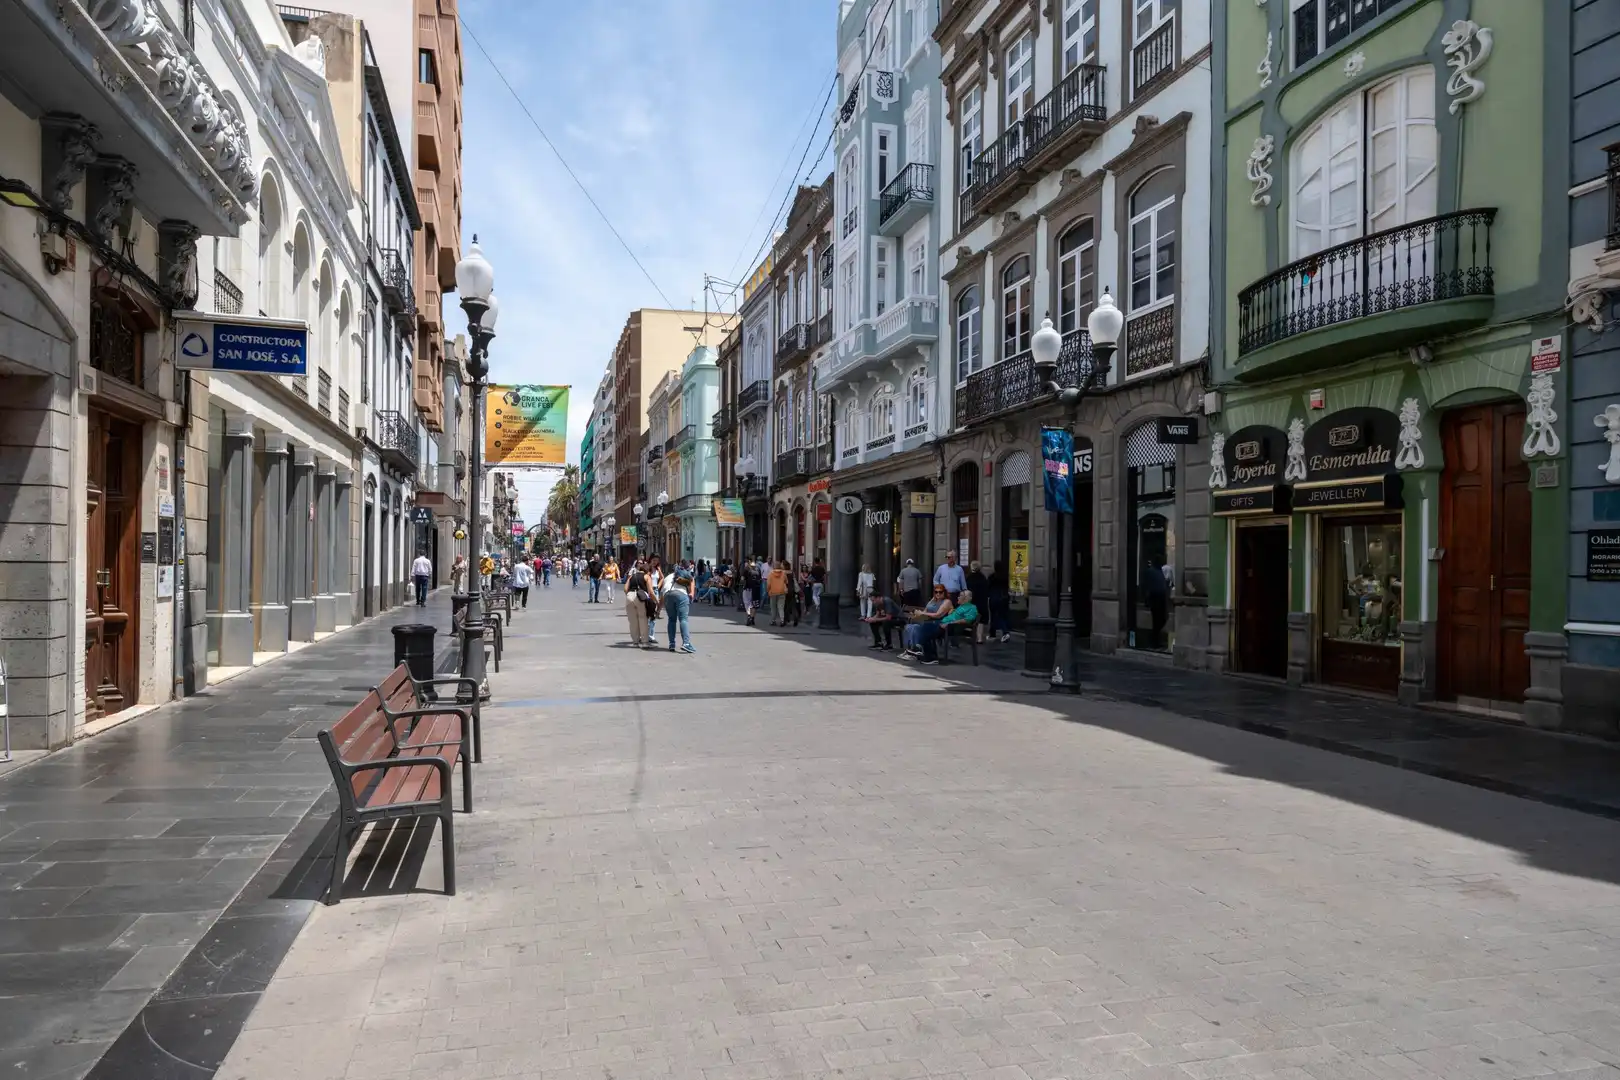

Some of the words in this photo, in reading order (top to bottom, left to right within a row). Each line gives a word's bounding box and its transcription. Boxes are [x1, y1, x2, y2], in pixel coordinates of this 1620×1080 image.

[219, 333, 302, 348] CONSTRUCTORA
[218, 348, 242, 360] SAN
[246, 350, 278, 364] JOSÉ,
[281, 353, 304, 364] S.A.
[1533, 353, 1559, 362] Alarma
[1166, 424, 1189, 435] VANS
[1310, 444, 1391, 471] Esmeralda
[1232, 460, 1276, 483] Joyería
[1230, 496, 1254, 506] GIFTS
[1308, 487, 1367, 502] JEWELLERY
